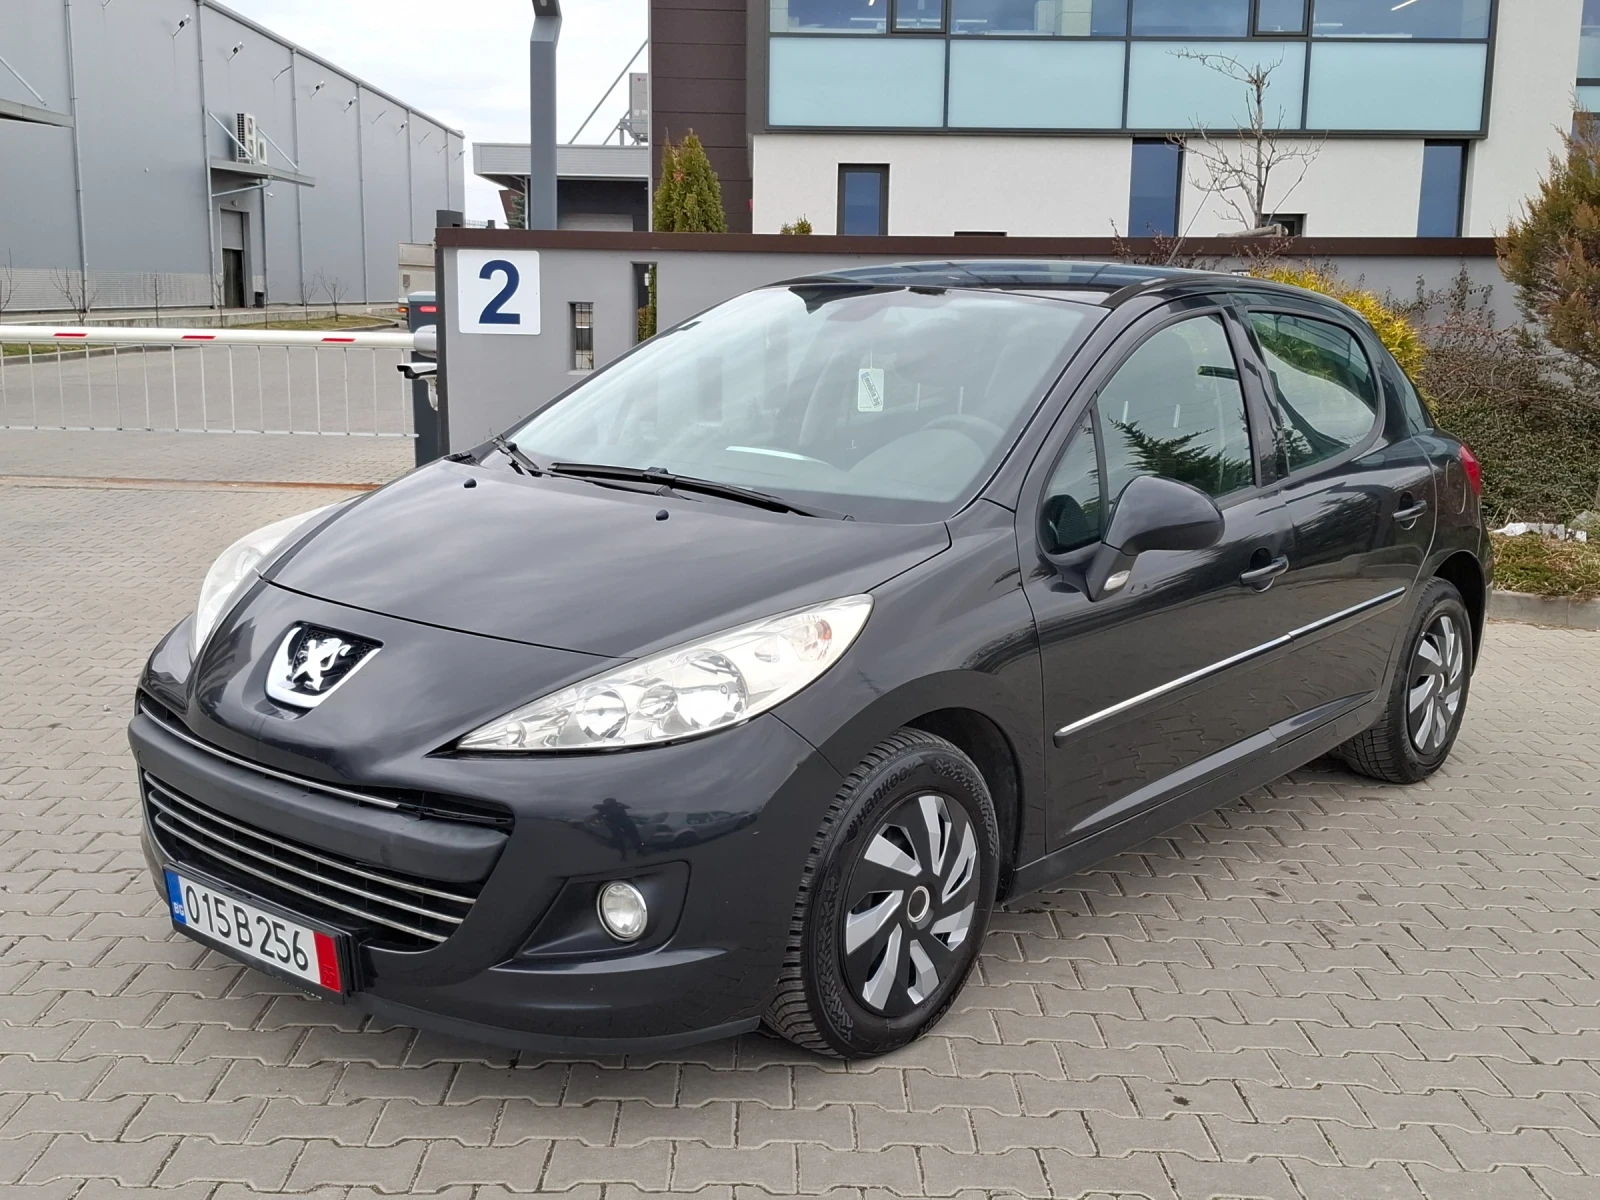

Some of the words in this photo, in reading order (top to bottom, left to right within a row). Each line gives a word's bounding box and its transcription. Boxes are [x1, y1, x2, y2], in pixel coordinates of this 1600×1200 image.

[479, 259, 520, 325] 2
[864, 377, 881, 406] mobile.bg
[173, 901, 185, 916] BG
[185, 884, 309, 971] 015B256
